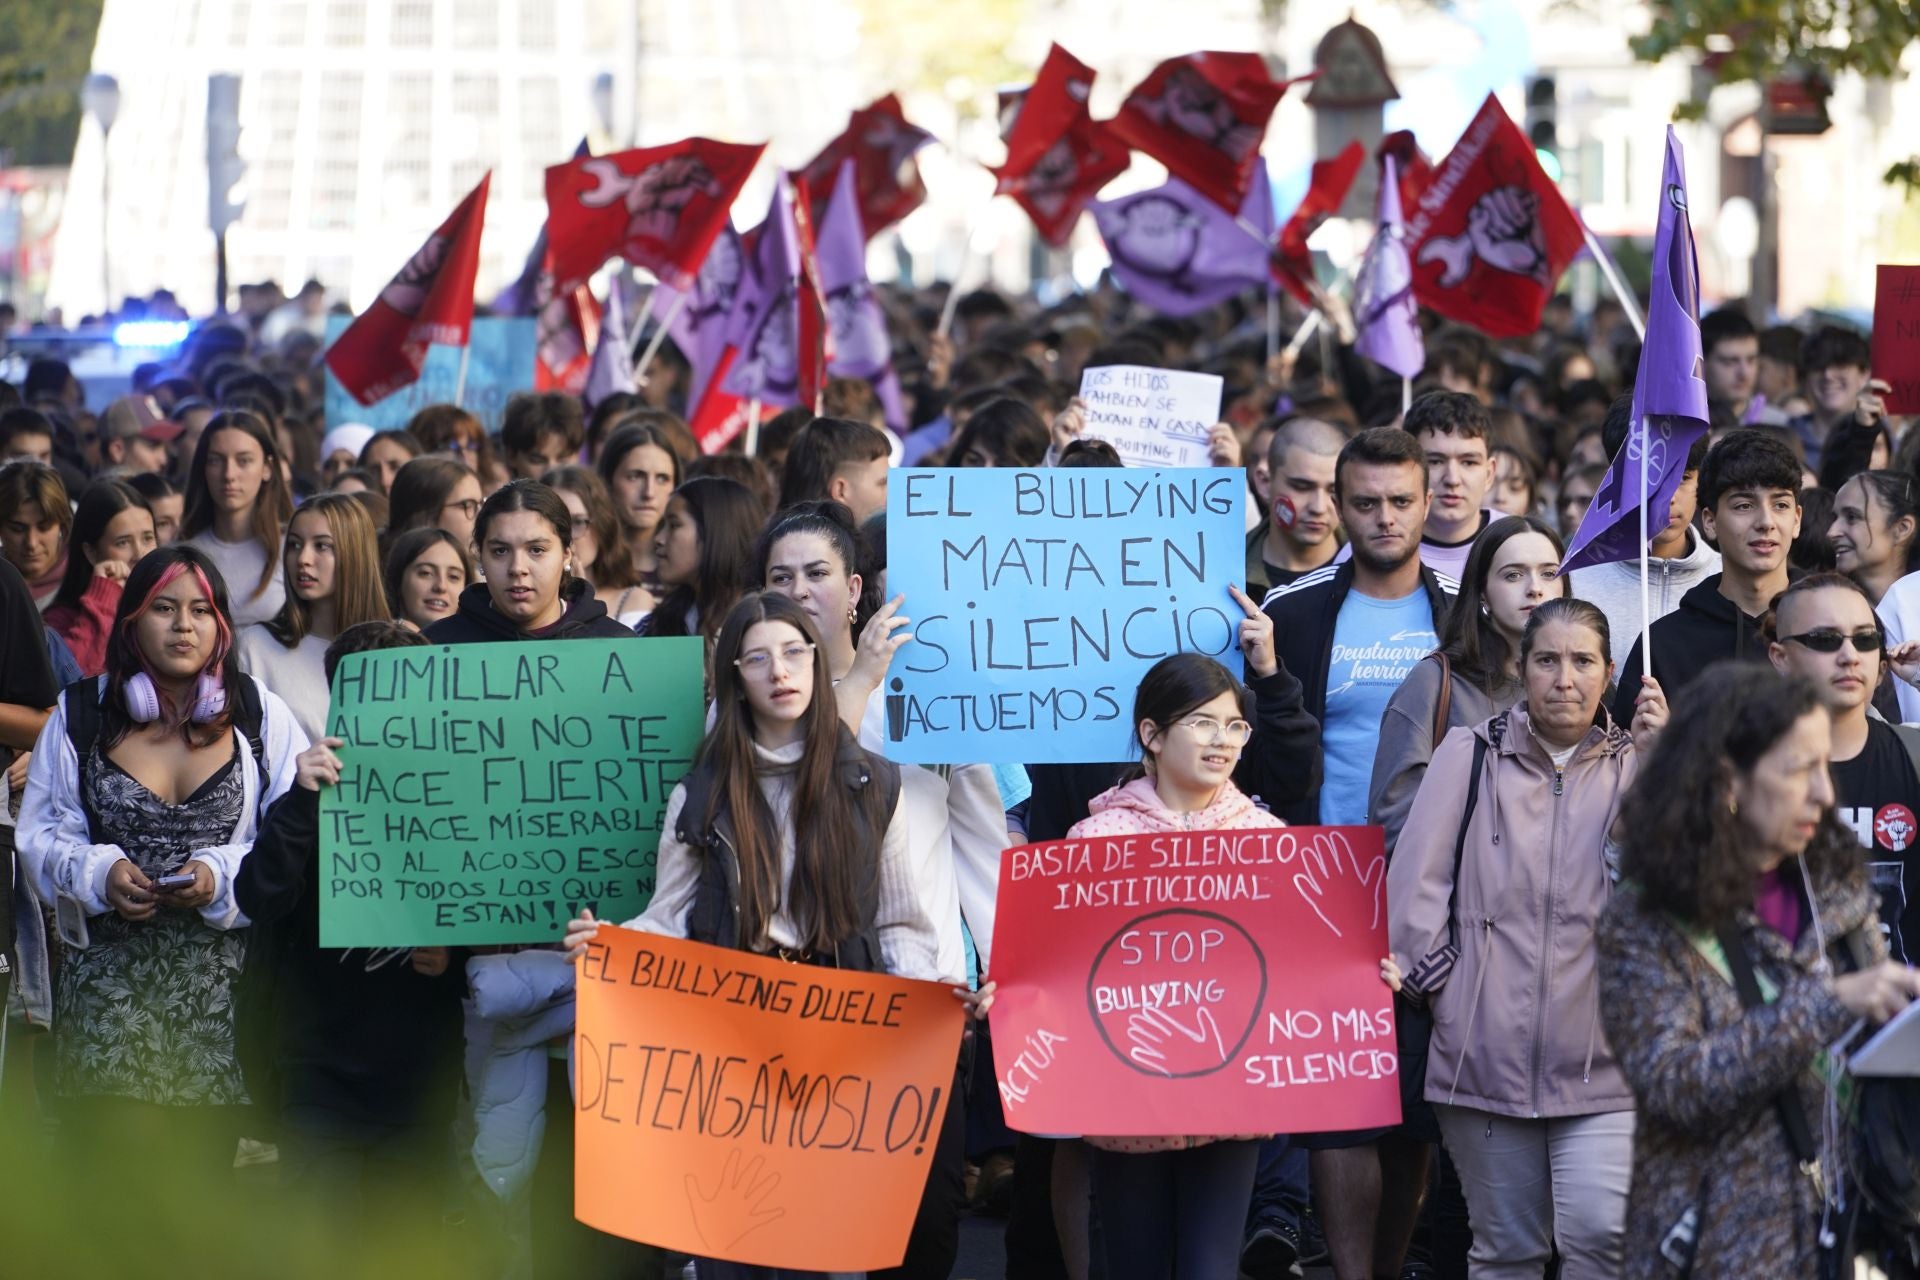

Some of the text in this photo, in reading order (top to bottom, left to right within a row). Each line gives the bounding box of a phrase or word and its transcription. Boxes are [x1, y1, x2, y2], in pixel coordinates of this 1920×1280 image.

[1156, 397, 1177, 411] SE
[1139, 417, 1160, 430] EN
[906, 474, 973, 517] EL
[943, 531, 1205, 591] MATA EN
[602, 652, 633, 693] A
[1350, 660, 1413, 680] herria
[532, 714, 592, 751] NO
[608, 714, 671, 754] TE
[336, 757, 694, 806] HACE FUERTE
[323, 809, 371, 846] TE
[385, 815, 479, 843] HACE
[333, 848, 658, 876] NO AL ACOSO ESCO
[1011, 833, 1297, 881] BASTA DE SILENCIO
[331, 878, 658, 900] POR TODOS LOS QUE N
[1054, 874, 1271, 910] INSTITUCIONAL
[1120, 929, 1225, 965] STOP
[583, 944, 908, 1028] EL BULLYING DUELE
[1095, 979, 1226, 1014] BULLYING
[1268, 1007, 1393, 1044] NO MAS
[1245, 1048, 1398, 1087] SILENCIO
